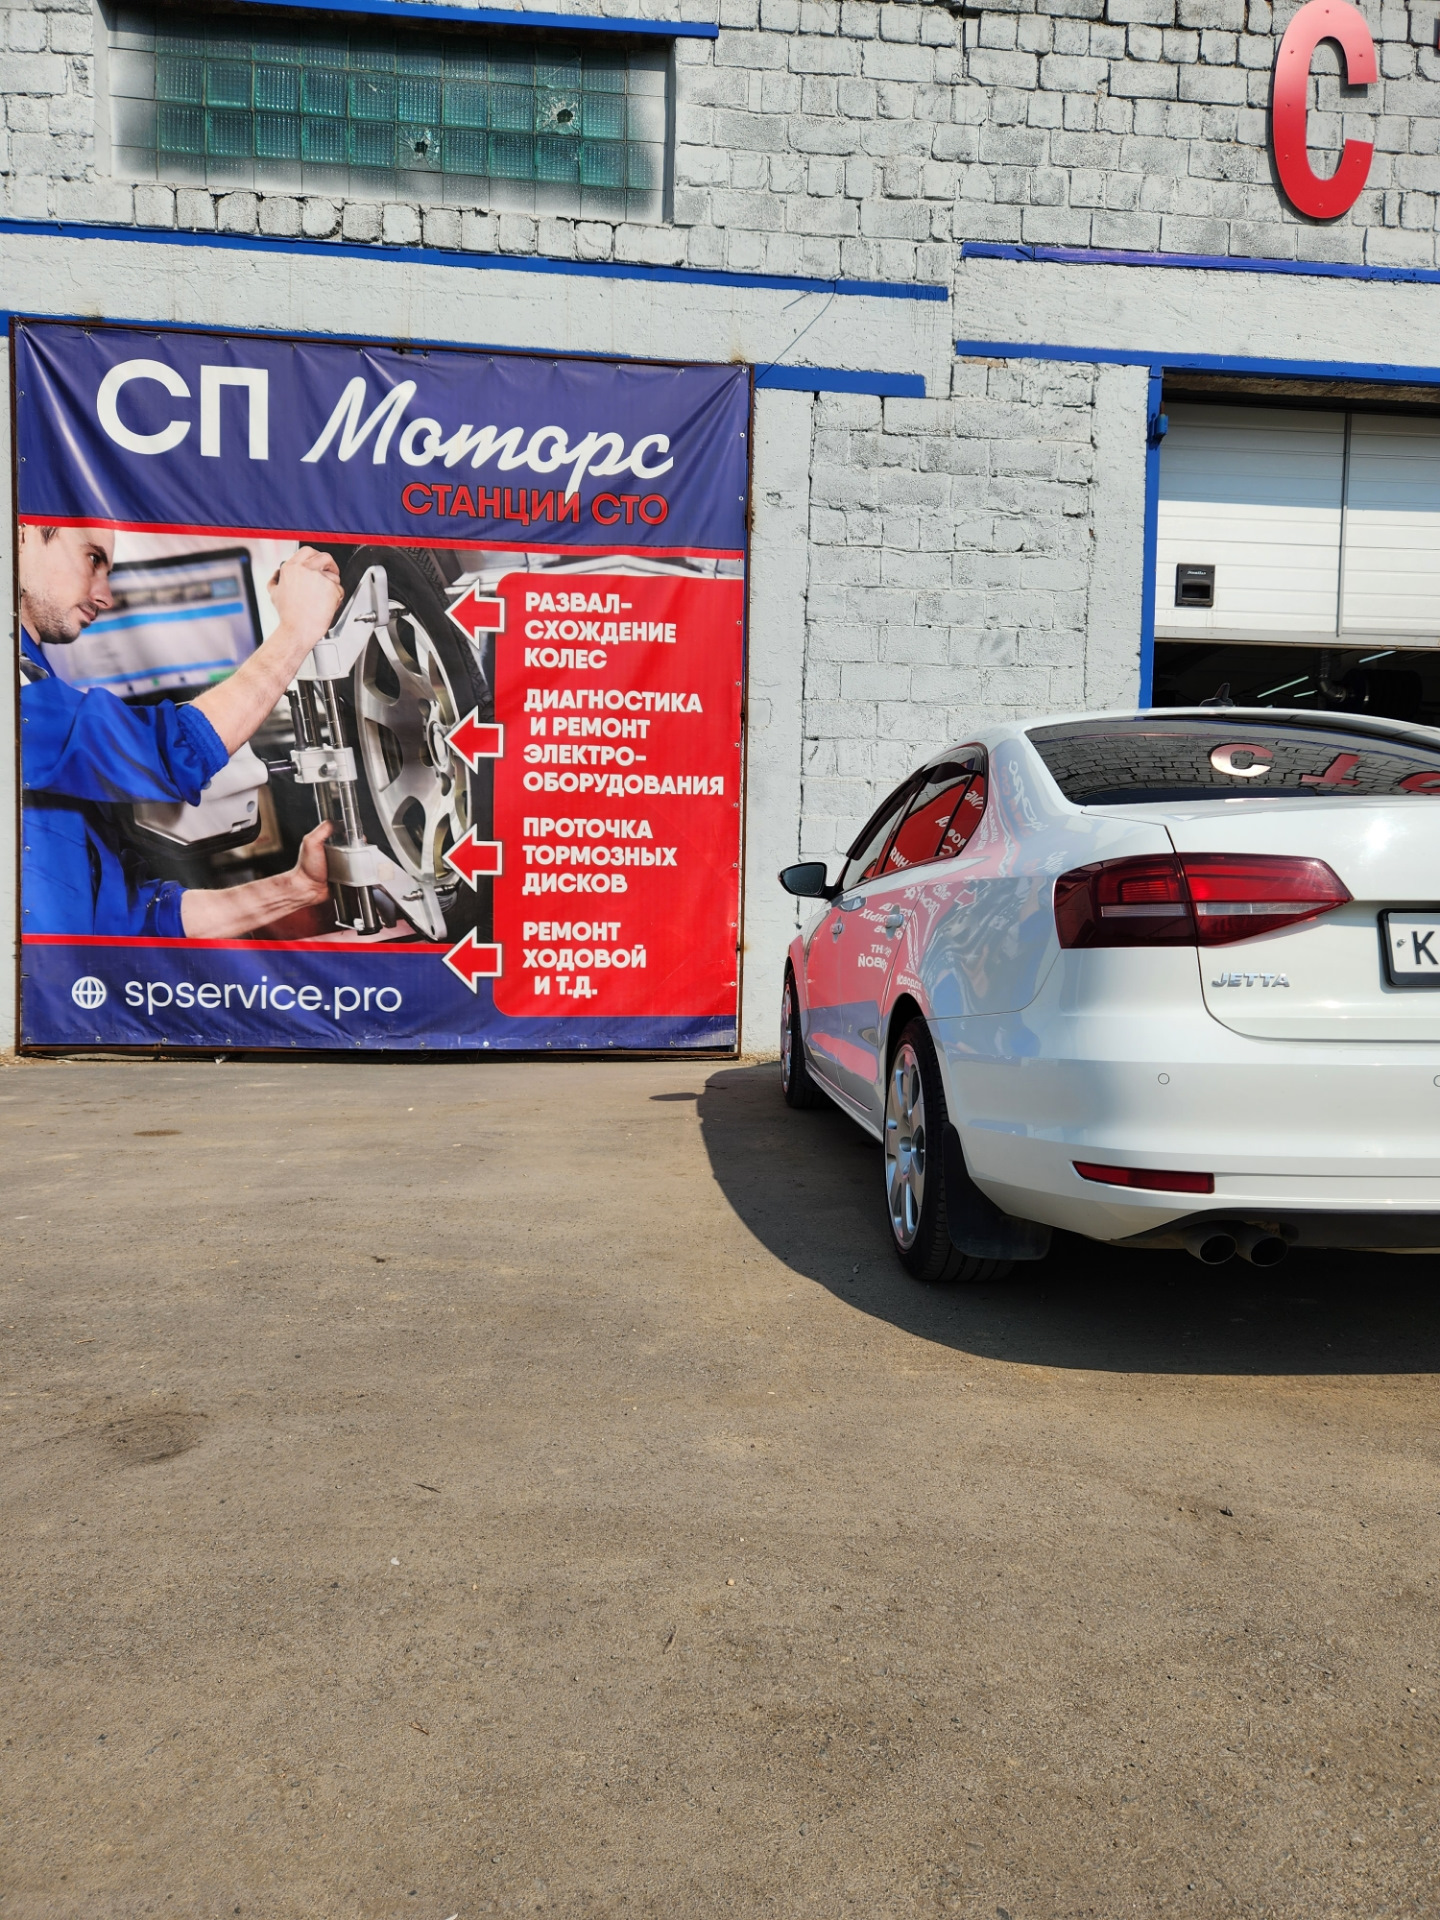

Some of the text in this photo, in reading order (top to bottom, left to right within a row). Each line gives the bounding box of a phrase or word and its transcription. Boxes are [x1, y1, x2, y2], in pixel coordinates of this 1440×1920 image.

[96, 358, 675, 504] СП Моторс
[401, 482, 670, 526] СТАНЦИИ СТО
[525, 592, 632, 614] РАЗВАЛ-
[524, 620, 677, 645] СХОЖДЕНИЕ
[524, 648, 607, 669] КОЛЕС
[523, 688, 703, 713] ДИАГНОСТИКА
[530, 717, 650, 739] И РЕМОНТ
[523, 744, 646, 767] ЭЛЕКТРО-
[523, 771, 724, 797] ОБОРУДОВАНИЯ
[523, 817, 653, 839] ПРОТОЧКА
[522, 845, 678, 867] ТОРМОЗНЫХ
[522, 873, 628, 896] ДИСКОВ
[523, 921, 621, 942] РЕМОНТ
[522, 944, 647, 972] ХОДОВОЙ
[534, 976, 598, 999] И Т.Д.
[1211, 972, 1290, 988] JETTA
[125, 976, 402, 1019] spservice.pro
